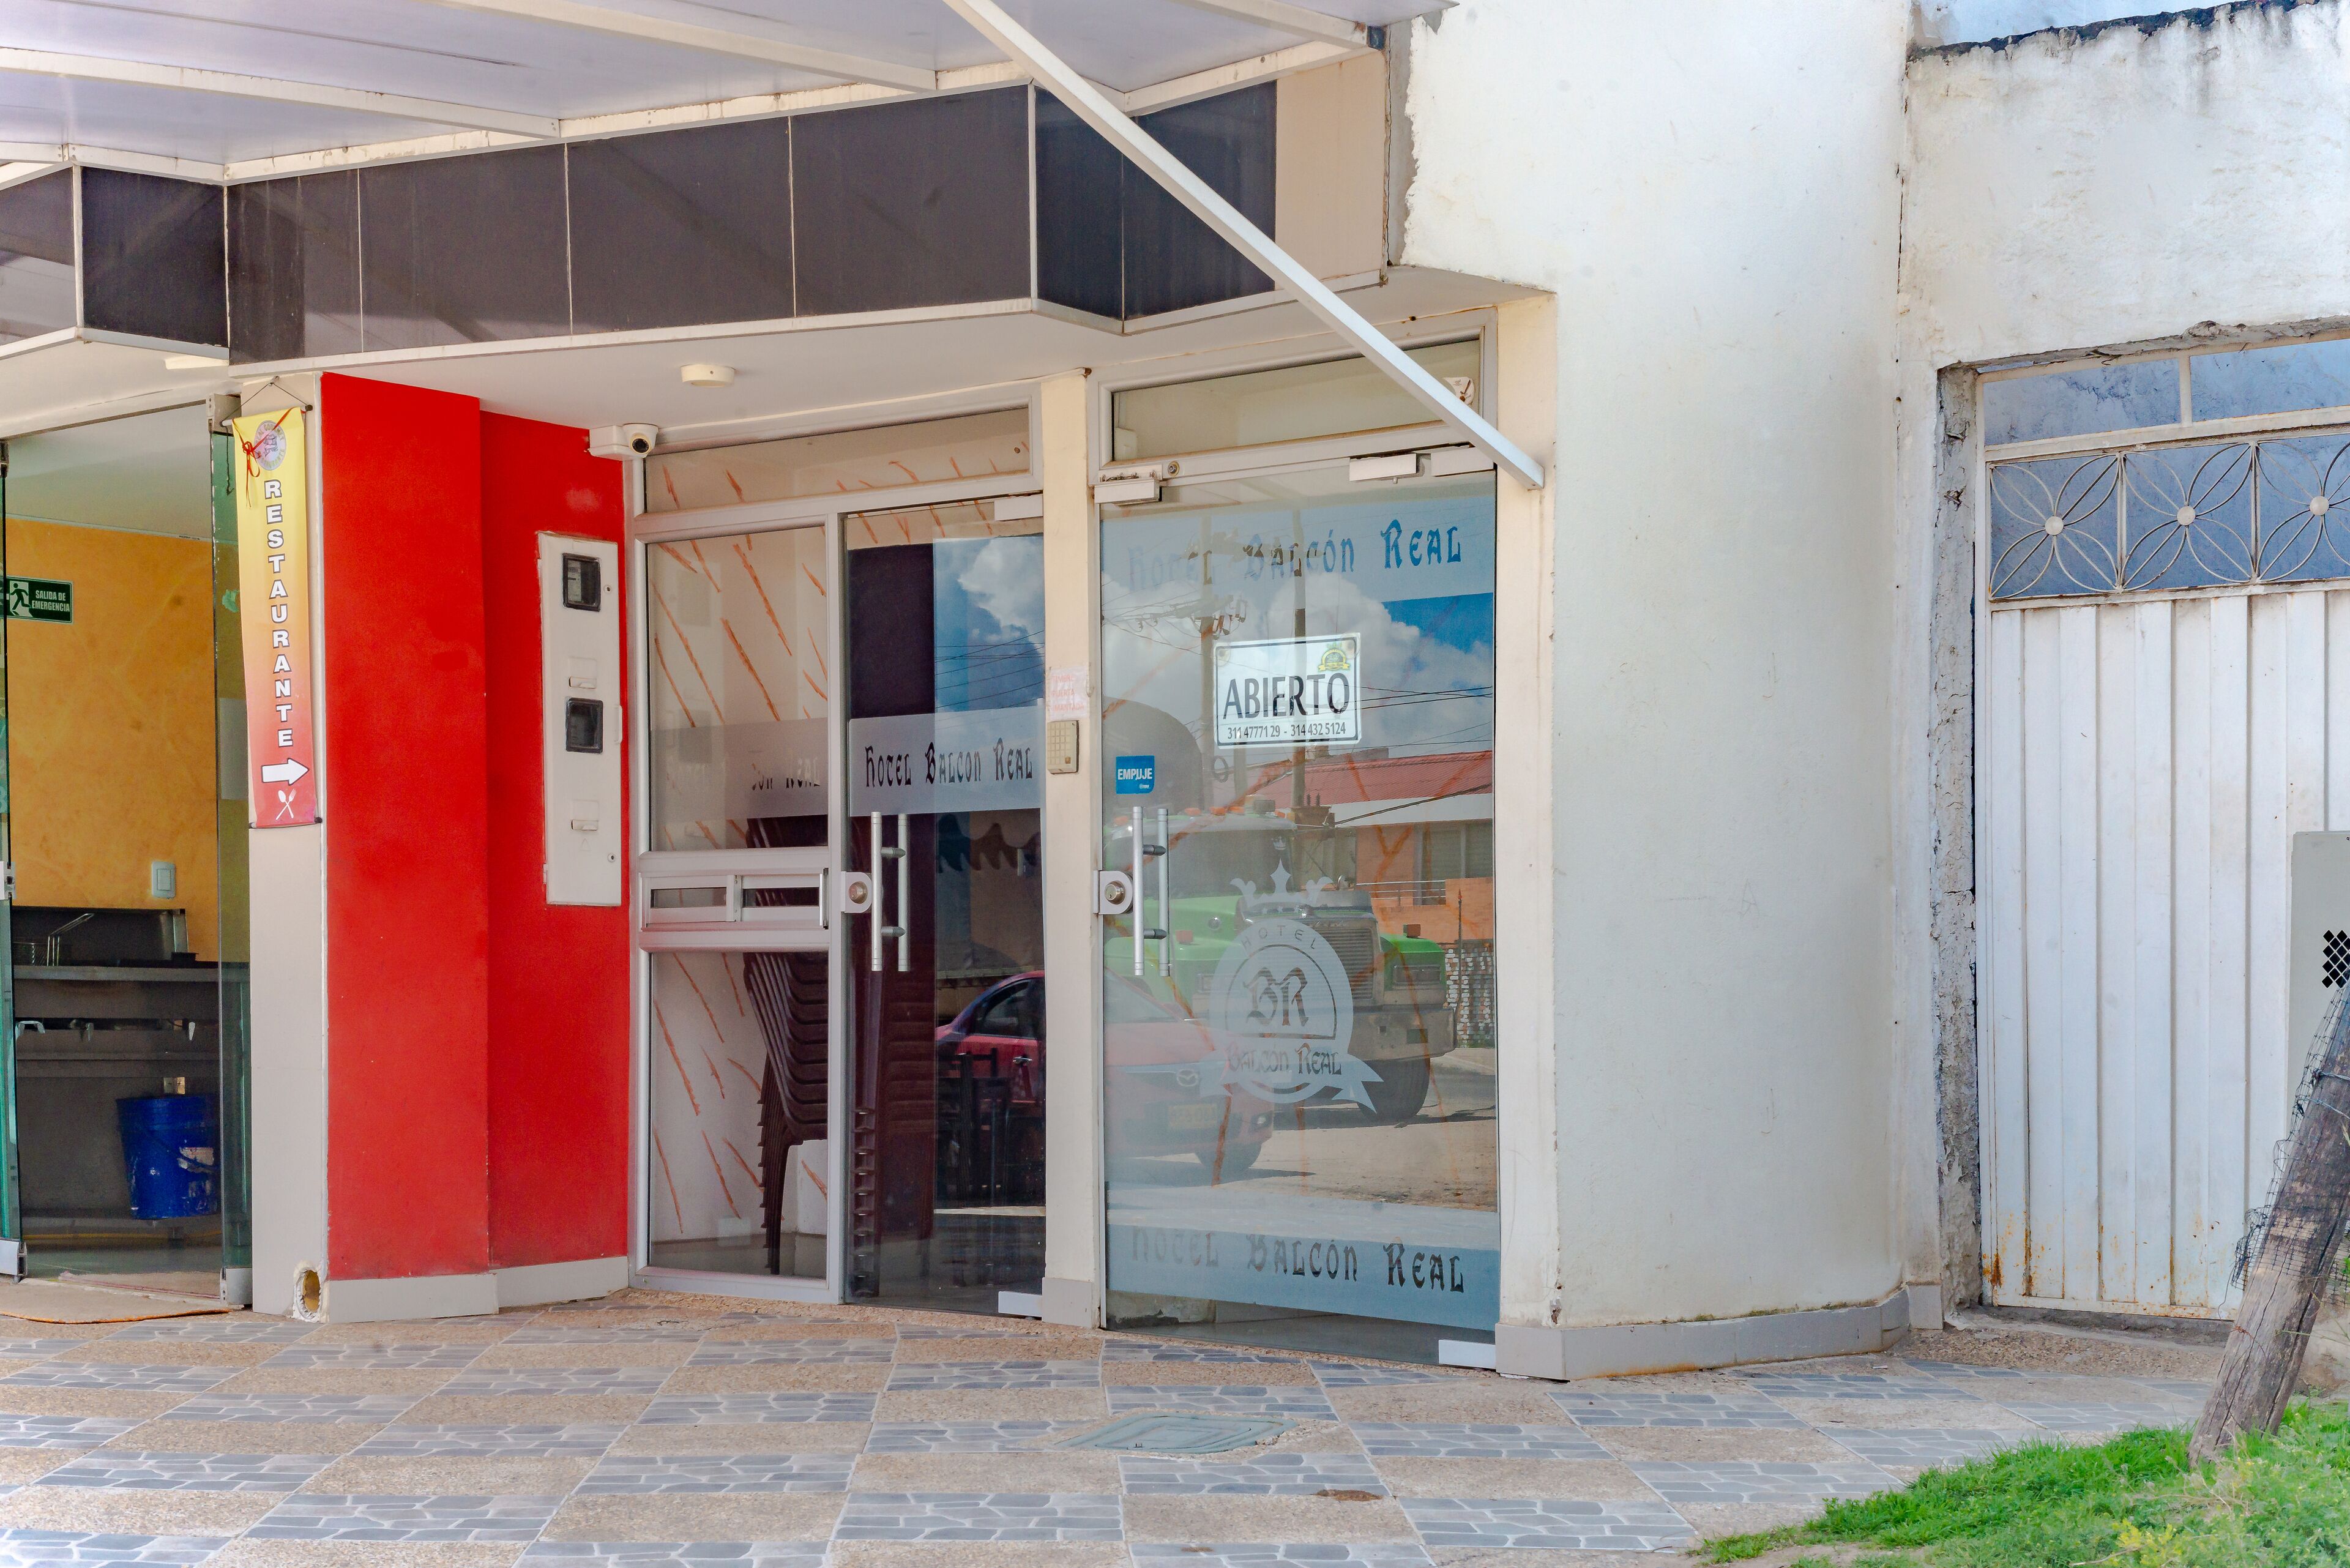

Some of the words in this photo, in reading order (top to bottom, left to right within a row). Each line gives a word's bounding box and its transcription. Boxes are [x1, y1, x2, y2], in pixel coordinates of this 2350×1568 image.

[35, 590, 57, 600] SALIDA
[58, 592, 66, 601] DE
[32, 600, 70, 612] EMERGENCIA
[264, 480, 294, 748] RESTAURANTE
[1223, 673, 1350, 720] ABIERTO
[1117, 768, 1152, 780] EMPUJE
[1240, 925, 1316, 950] HOTEL
